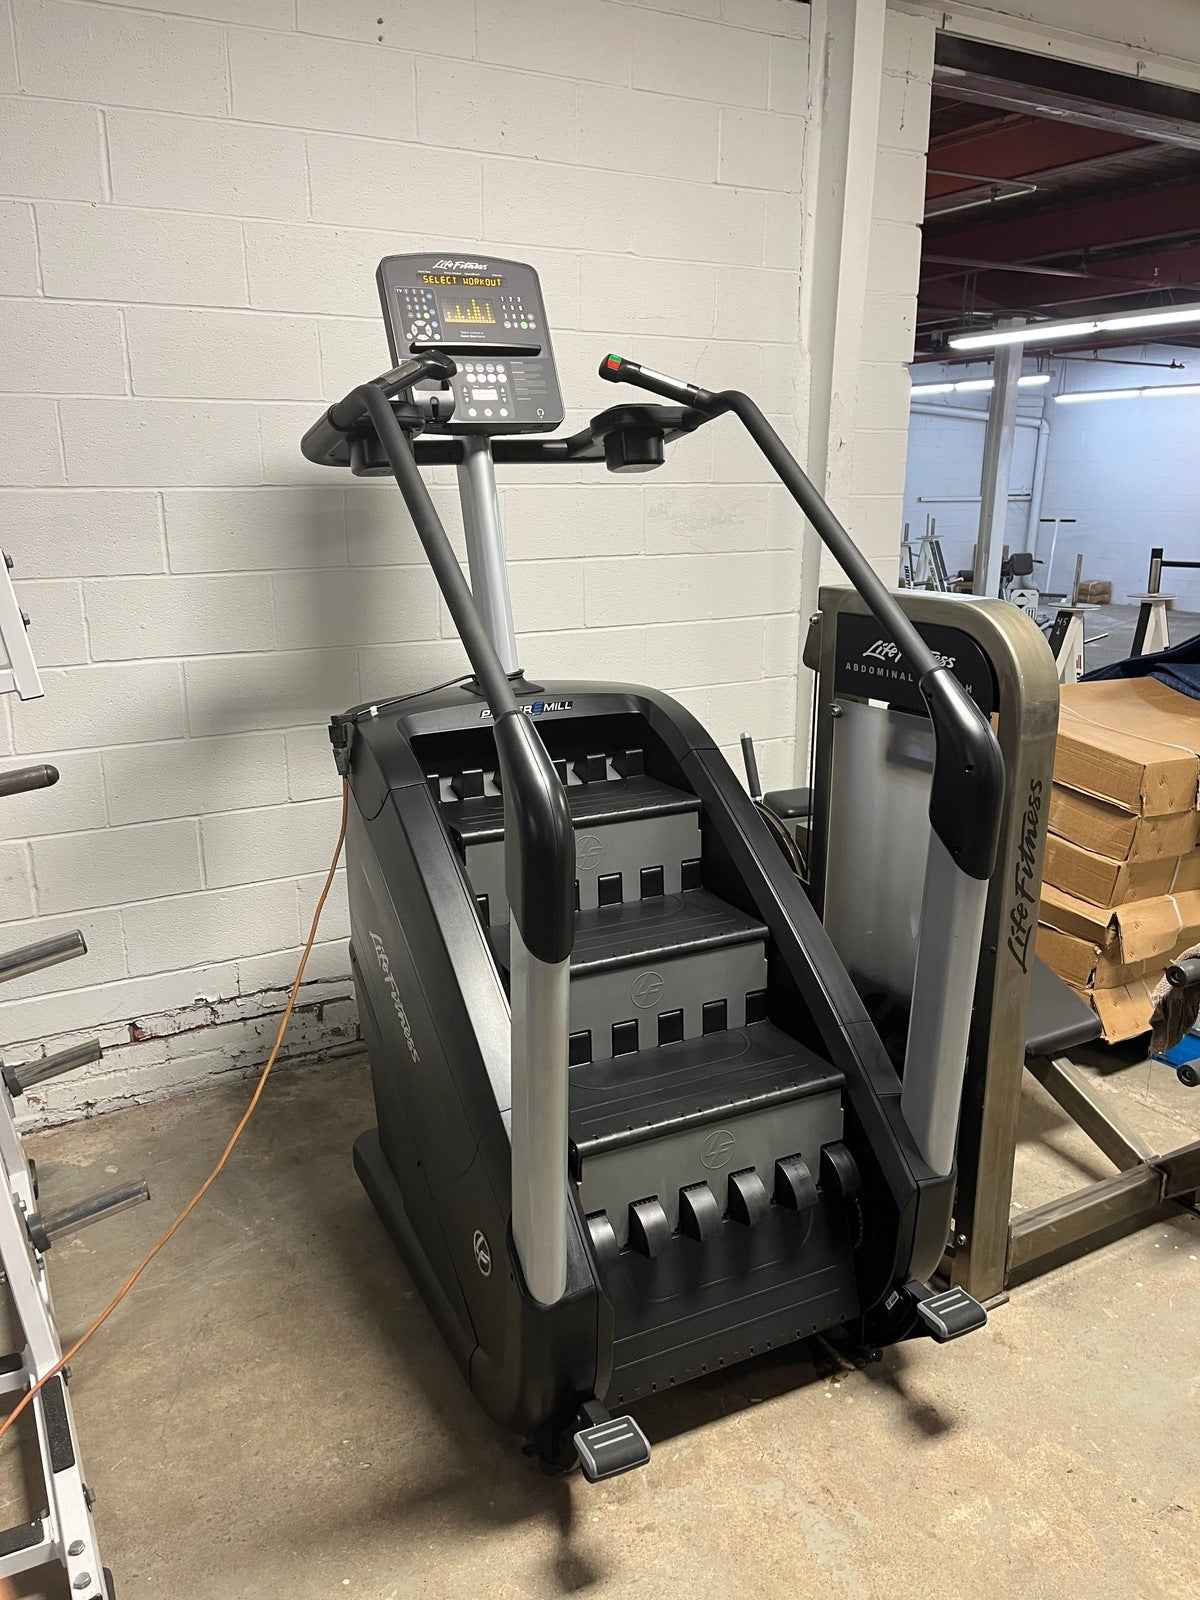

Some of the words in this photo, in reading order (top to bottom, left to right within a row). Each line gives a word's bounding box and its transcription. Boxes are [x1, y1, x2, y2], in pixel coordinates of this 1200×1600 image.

[422, 274, 457, 285] SELECT
[462, 277, 501, 287] WORKOUT
[862, 639, 898, 661] Life
[845, 661, 914, 682] ABDOMINAL
[1015, 778, 1043, 903] Fitness
[1007, 902, 1033, 975] Life
